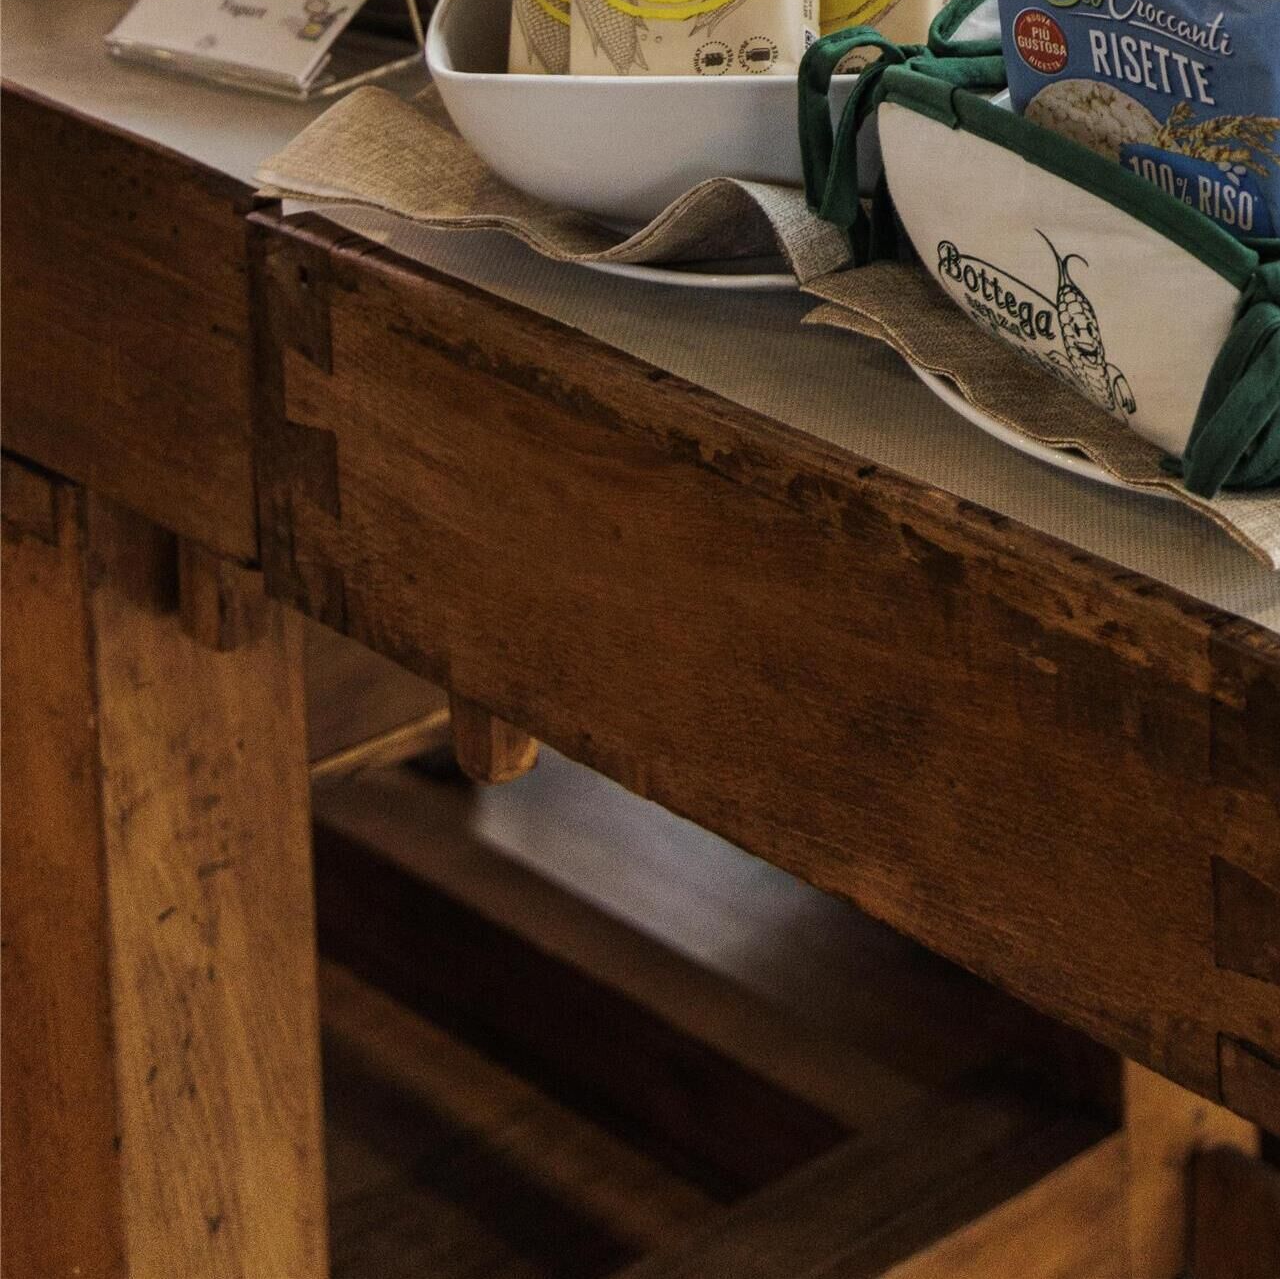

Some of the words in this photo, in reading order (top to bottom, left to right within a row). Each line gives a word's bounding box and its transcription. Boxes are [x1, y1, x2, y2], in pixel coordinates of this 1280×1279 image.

[1017, 35, 1068, 57] GUSTOSA
[1089, 29, 1216, 106] RISETTE
[1197, 175, 1254, 232] RISO
[938, 240, 1057, 341] Bottega
